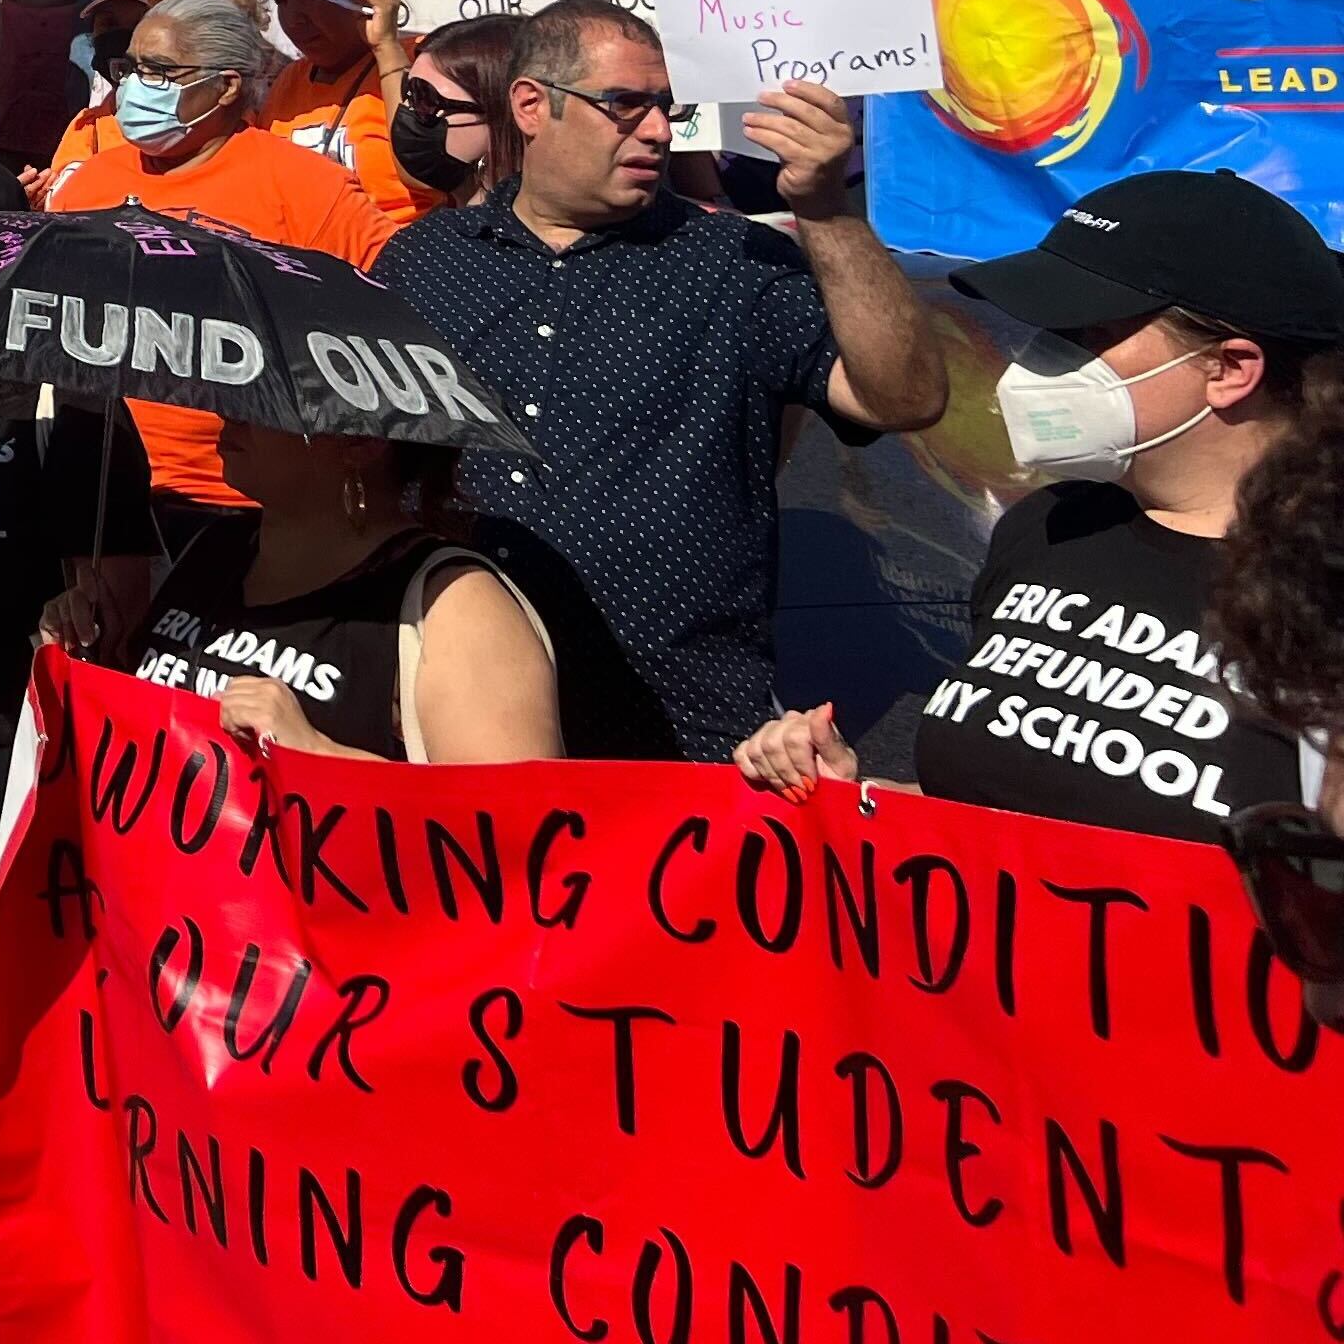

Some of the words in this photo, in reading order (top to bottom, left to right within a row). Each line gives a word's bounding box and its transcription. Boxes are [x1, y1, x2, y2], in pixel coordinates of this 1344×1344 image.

[752, 33, 930, 87] Programs!
[5, 287, 265, 386] FUND
[306, 330, 500, 425] OUR
[204, 631, 342, 701] ADAMS
[992, 583, 1090, 632] ERIC
[923, 679, 992, 724] MY
[986, 694, 1231, 818] SCHOOL
[967, 634, 1230, 741] DEFUNDED
[89, 714, 593, 931] WORKING
[148, 915, 393, 1095] OUR
